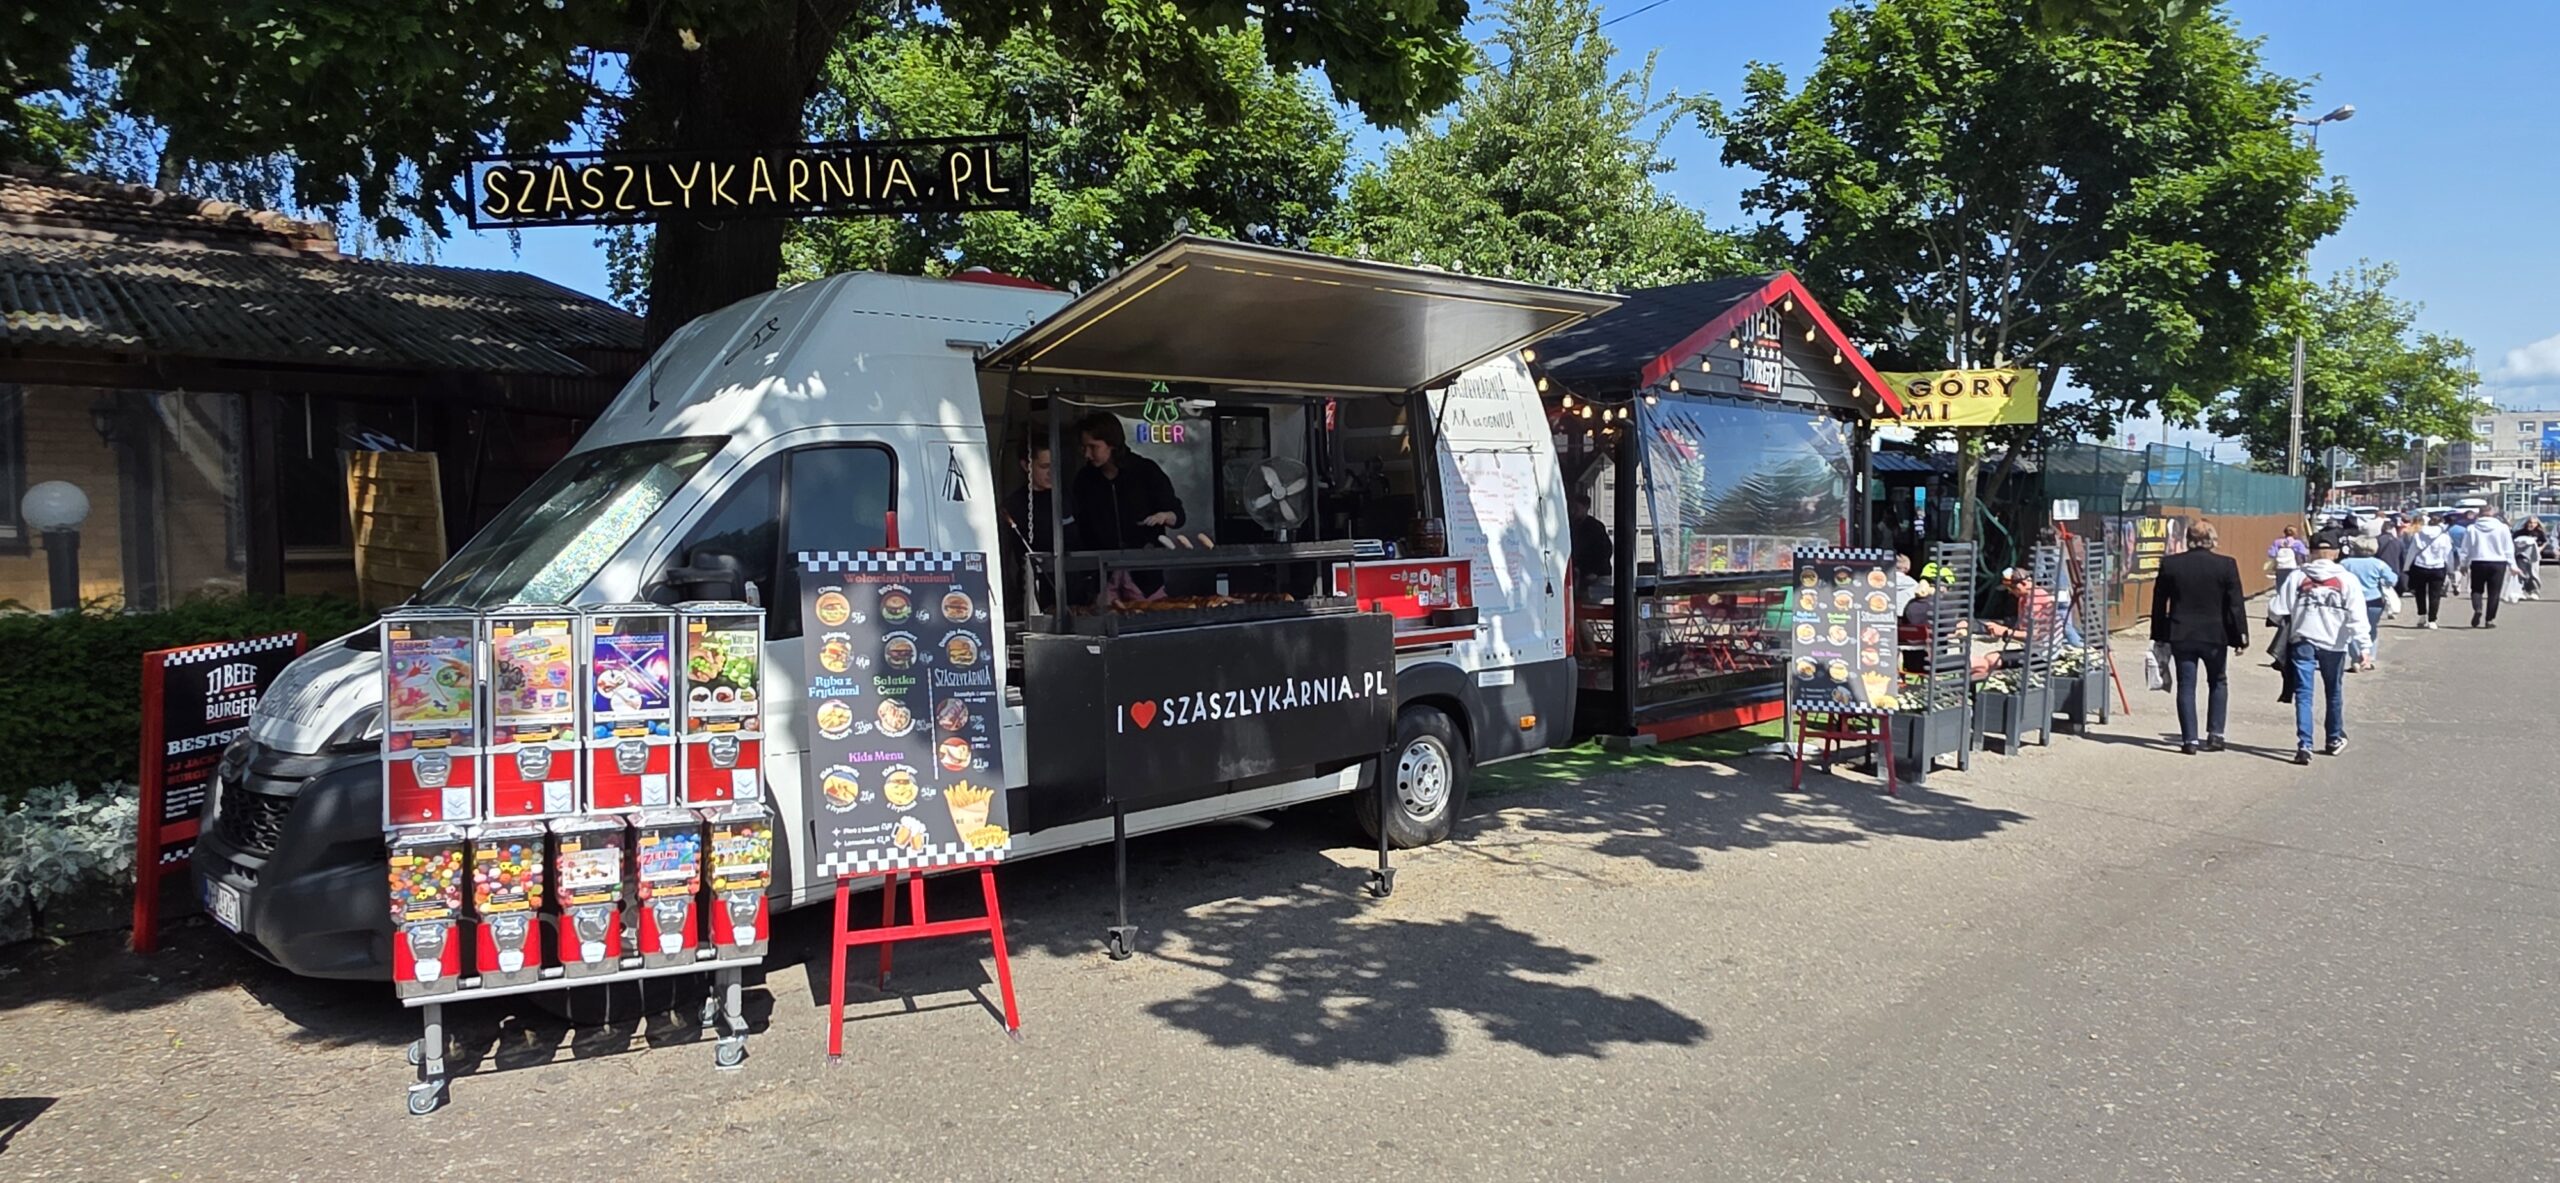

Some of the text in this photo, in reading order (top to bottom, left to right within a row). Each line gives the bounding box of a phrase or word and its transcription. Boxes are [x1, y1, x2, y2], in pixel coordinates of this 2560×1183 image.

[486, 147, 1010, 215] SZASZLYKARNIA.PL
[1743, 358, 1782, 393] BURGER
[1907, 371, 2019, 398] GÓRY
[1136, 424, 1185, 443] BEER
[205, 663, 258, 695] JJ BEEF
[815, 676, 844, 688] Ryba
[877, 686, 908, 695] Cezar
[808, 685, 860, 698] Frytkami
[1117, 671, 1388, 733] I SZASZLYKARNIA.PL
[206, 697, 258, 721] BURGER
[848, 751, 905, 762] Kids Menu
